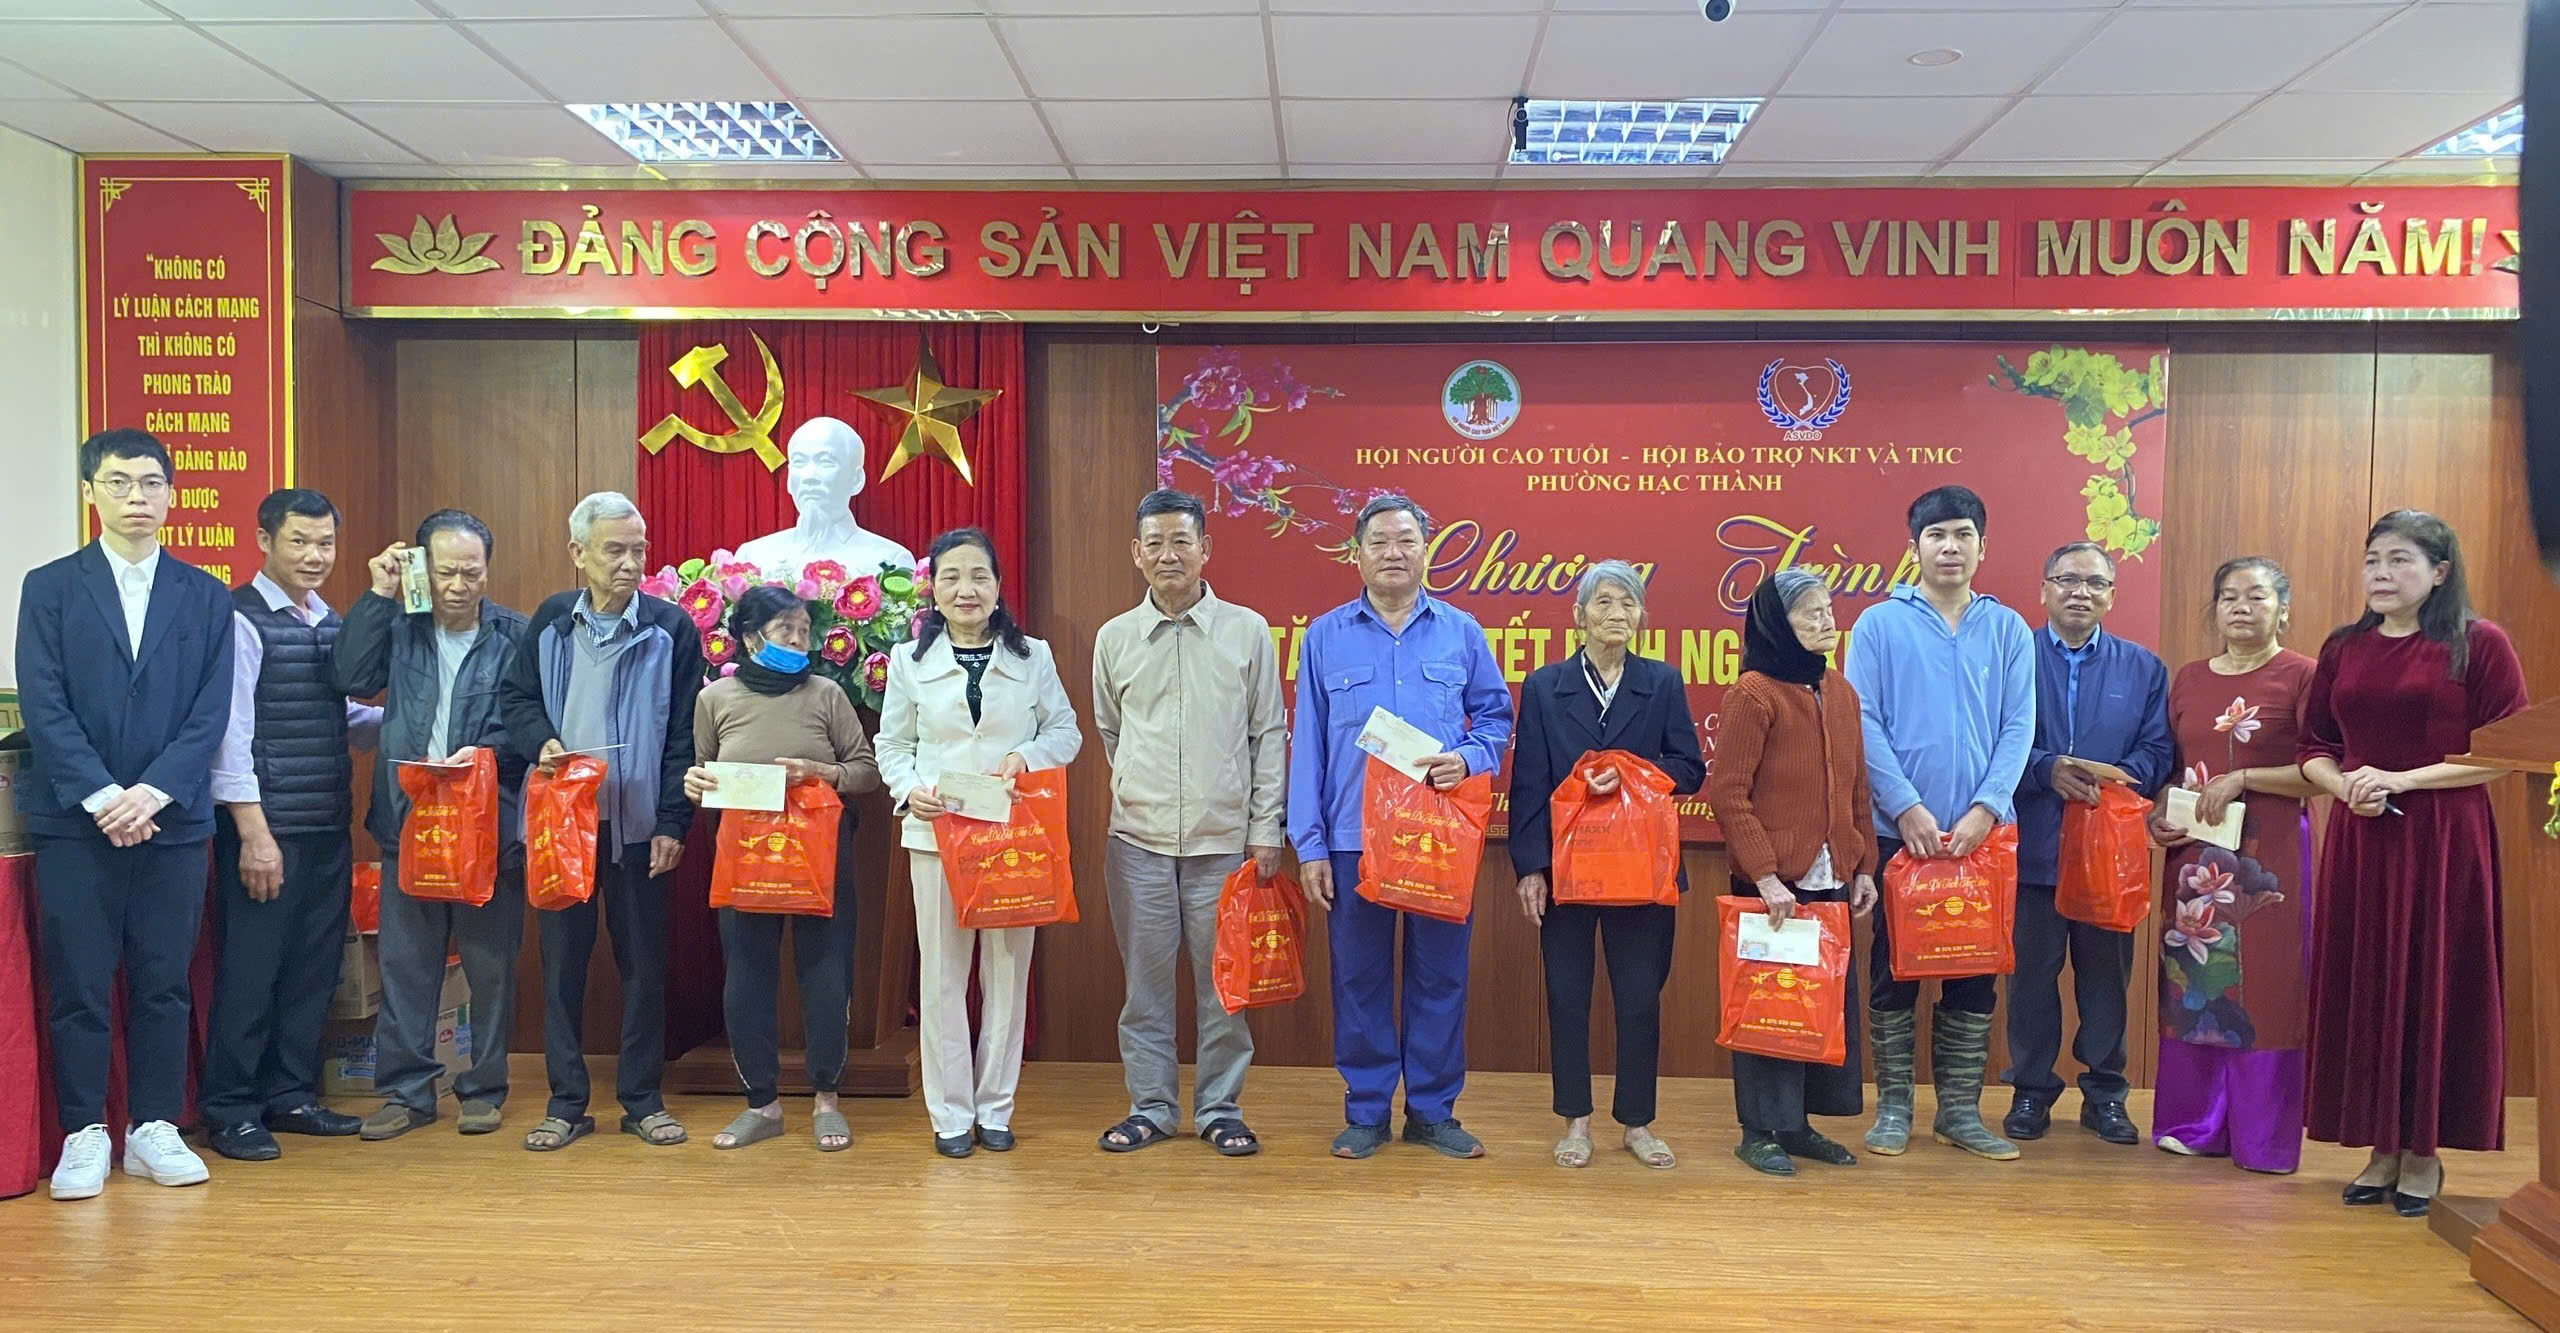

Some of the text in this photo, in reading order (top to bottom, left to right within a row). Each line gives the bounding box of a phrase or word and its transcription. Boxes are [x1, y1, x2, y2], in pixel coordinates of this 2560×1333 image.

[518, 199, 2488, 295] ĐẢNG CỘNG SẢN VIỆT NAM QUANG VINH MUÔN NĂM!
[206, 255, 226, 280] CÓ
[113, 293, 260, 323] LÝ LUẬN CÁCH MẠNG
[138, 331, 236, 357] THÌ KHÔNG CÓ
[143, 370, 232, 395] PHONG TRÀO
[146, 408, 230, 437] CÁCH MẠNG
[1784, 430, 1822, 441] ASVDO
[175, 444, 214, 471] ĐẢNG
[217, 446, 247, 471] NÀO
[1356, 446, 1399, 469] HỘI
[1406, 443, 1485, 465] NGƯỜI
[1492, 448, 1544, 465] CAO
[1550, 443, 1609, 465] TUỔI
[1641, 445, 1686, 468] HỘI
[1695, 442, 1745, 464] BẢO
[1751, 446, 1803, 468] TRỢ
[1810, 447, 1861, 464] NKT
[1867, 442, 1900, 464] VÀ
[1907, 447, 1963, 464] TMC
[1527, 470, 1783, 495] PHƯỜNG HẠC THÀNH
[181, 487, 219, 513] ĐƯỢC
[177, 522, 194, 547] LÝ
[198, 522, 235, 551] LUẬN
